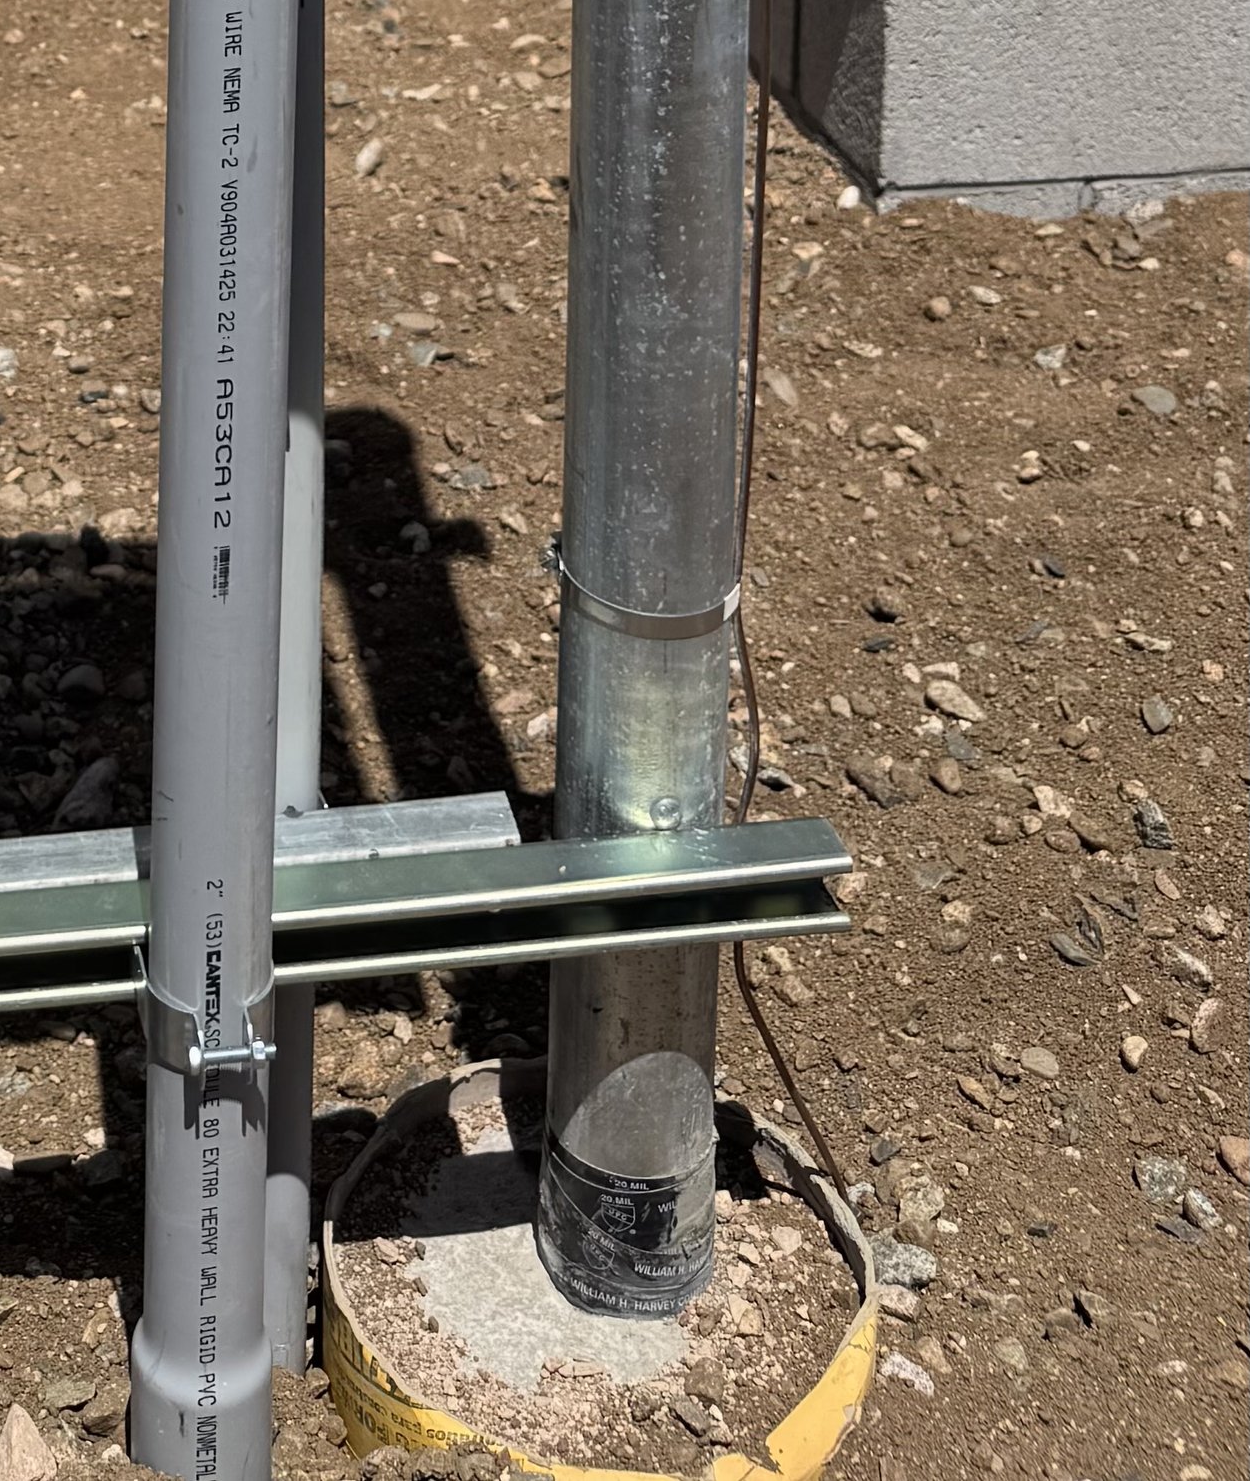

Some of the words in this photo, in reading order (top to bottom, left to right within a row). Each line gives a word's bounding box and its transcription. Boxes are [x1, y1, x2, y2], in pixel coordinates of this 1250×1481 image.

[224, 11, 242, 57] WIRE
[222, 67, 241, 114] NEMA
[221, 123, 239, 169] TC-2
[218, 179, 238, 301] V904A031425
[217, 311, 235, 364] 22:41
[214, 378, 234, 529] A53CA12
[203, 1028, 221, 1109] SCDULE
[203, 1118, 220, 1138] 80
[202, 1147, 220, 1199] EXTRA
[630, 1182, 649, 1191] MIL
[615, 1197, 634, 1206] MIL
[201, 1207, 218, 1256] HEAVY
[200, 1266, 217, 1307] WALL
[634, 1262, 676, 1277] WILLIAM
[570, 1278, 616, 1306] WILLIAM
[634, 1298, 676, 1312] HARVEY
[199, 1316, 217, 1365] RIGID
[197, 1373, 216, 1407] PVC
[196, 1415, 217, 1481] NONMETAL
